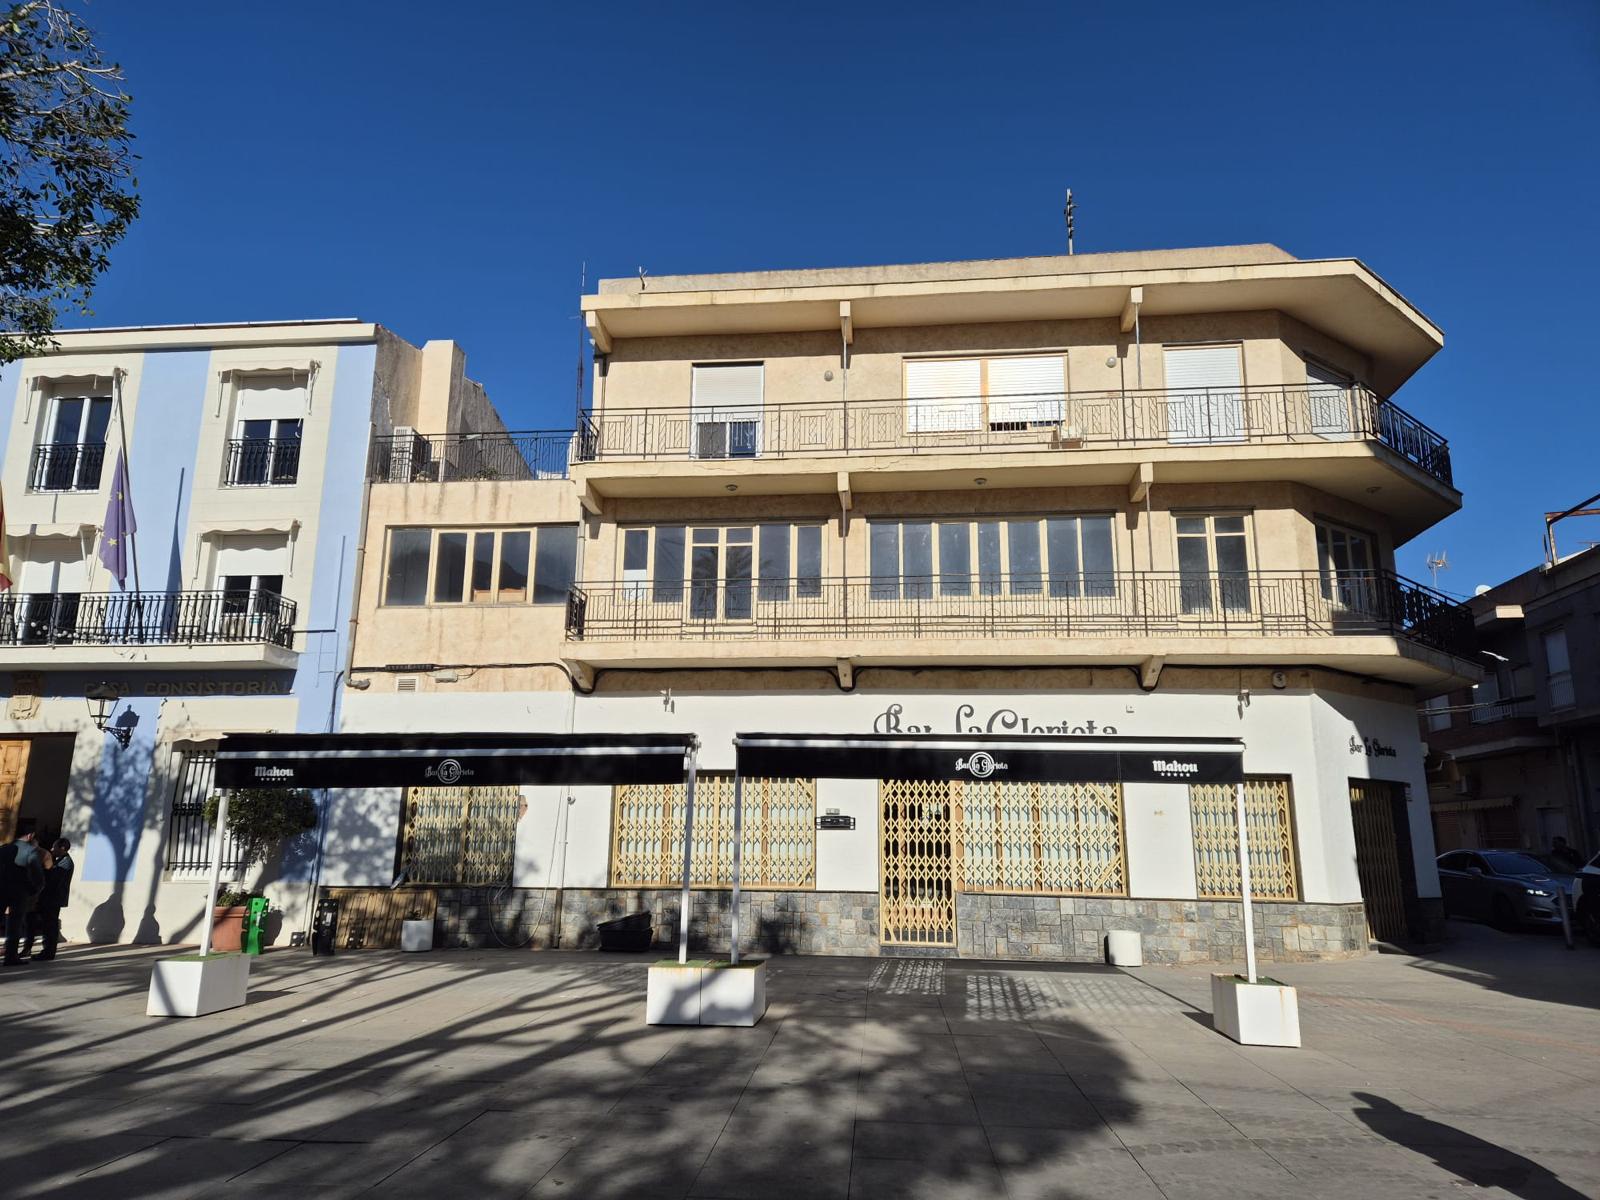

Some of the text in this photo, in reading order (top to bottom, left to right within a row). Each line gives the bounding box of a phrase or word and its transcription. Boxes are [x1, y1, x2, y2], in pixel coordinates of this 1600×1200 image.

[84, 681, 290, 696] CSA CONSISTORIAL
[255, 766, 294, 777] Mahou
[1152, 760, 1199, 772] Mahou
